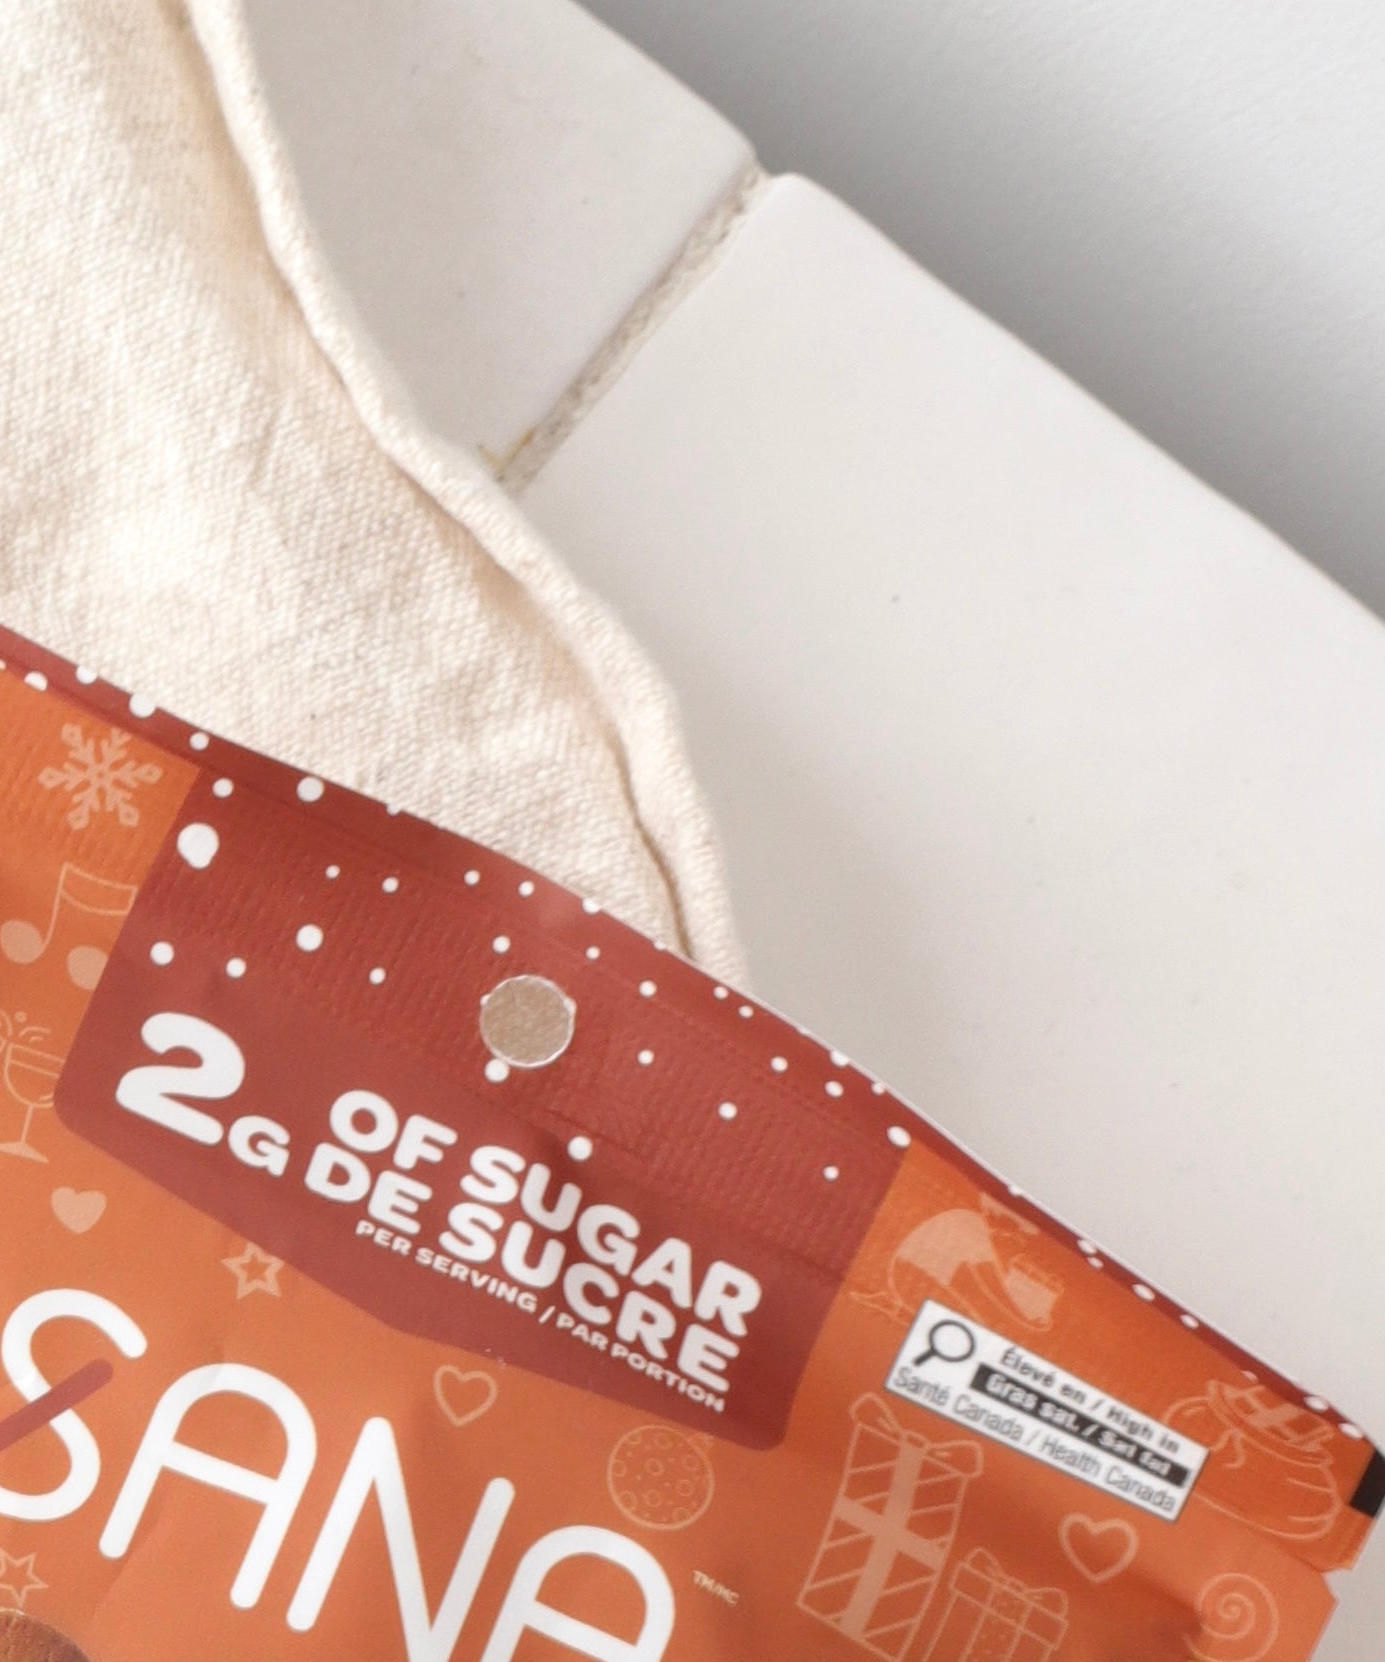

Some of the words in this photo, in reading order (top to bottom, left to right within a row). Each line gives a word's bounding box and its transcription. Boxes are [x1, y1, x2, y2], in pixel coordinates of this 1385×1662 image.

[303, 1142, 432, 1236] DE
[438, 1204, 739, 1394] SUCRE
[329, 1088, 458, 1171] OF
[460, 1145, 762, 1339] SUGAR
[356, 1220, 412, 1259] PER
[415, 1245, 538, 1314] SERVING
[555, 1311, 610, 1354] PAR
[609, 1340, 726, 1413] PORTION
[985, 1374, 1036, 1409] Gras
[1001, 1346, 1054, 1388] Élevé
[1060, 1381, 1087, 1403] en
[1106, 1405, 1154, 1442] High
[1156, 1433, 1180, 1454] in
[893, 1367, 952, 1406] Santé
[953, 1393, 1024, 1441] Canada
[1042, 1434, 1103, 1479] Health
[1104, 1464, 1177, 1511] Canada
